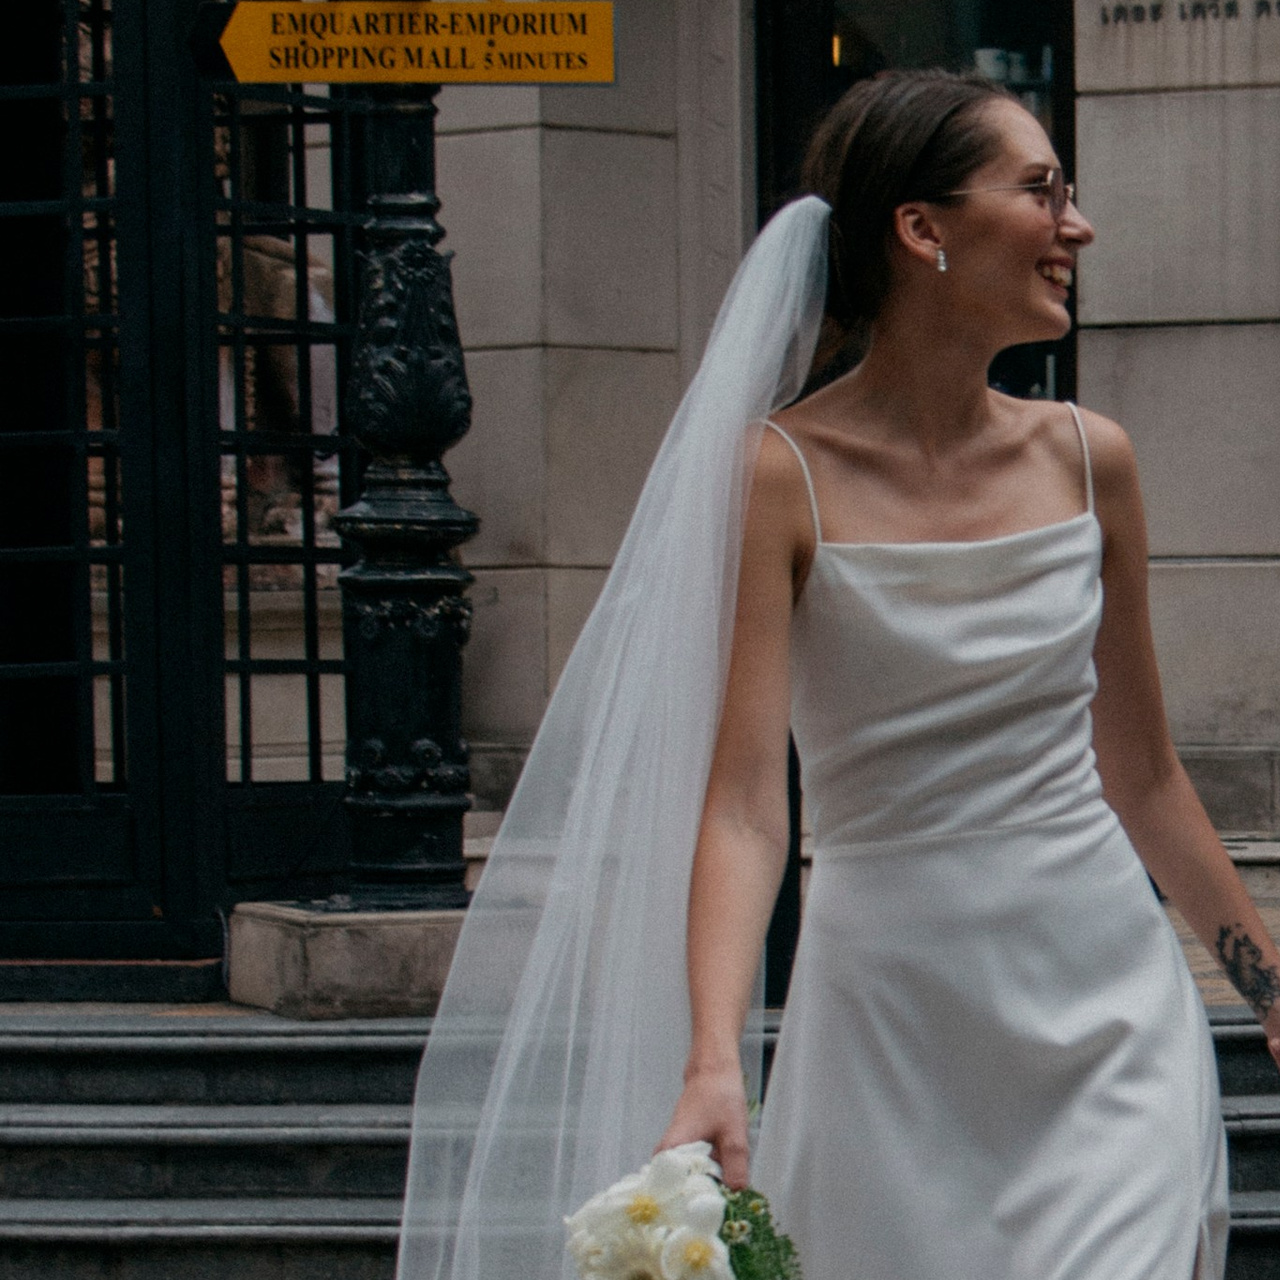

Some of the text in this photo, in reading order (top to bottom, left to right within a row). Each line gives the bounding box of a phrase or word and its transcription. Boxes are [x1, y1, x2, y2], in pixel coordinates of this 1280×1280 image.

[271, 11, 588, 37] EMQUARTIER-EMPORIUM
[269, 46, 588, 70] SHOPPING MALL 5 MINUTES
